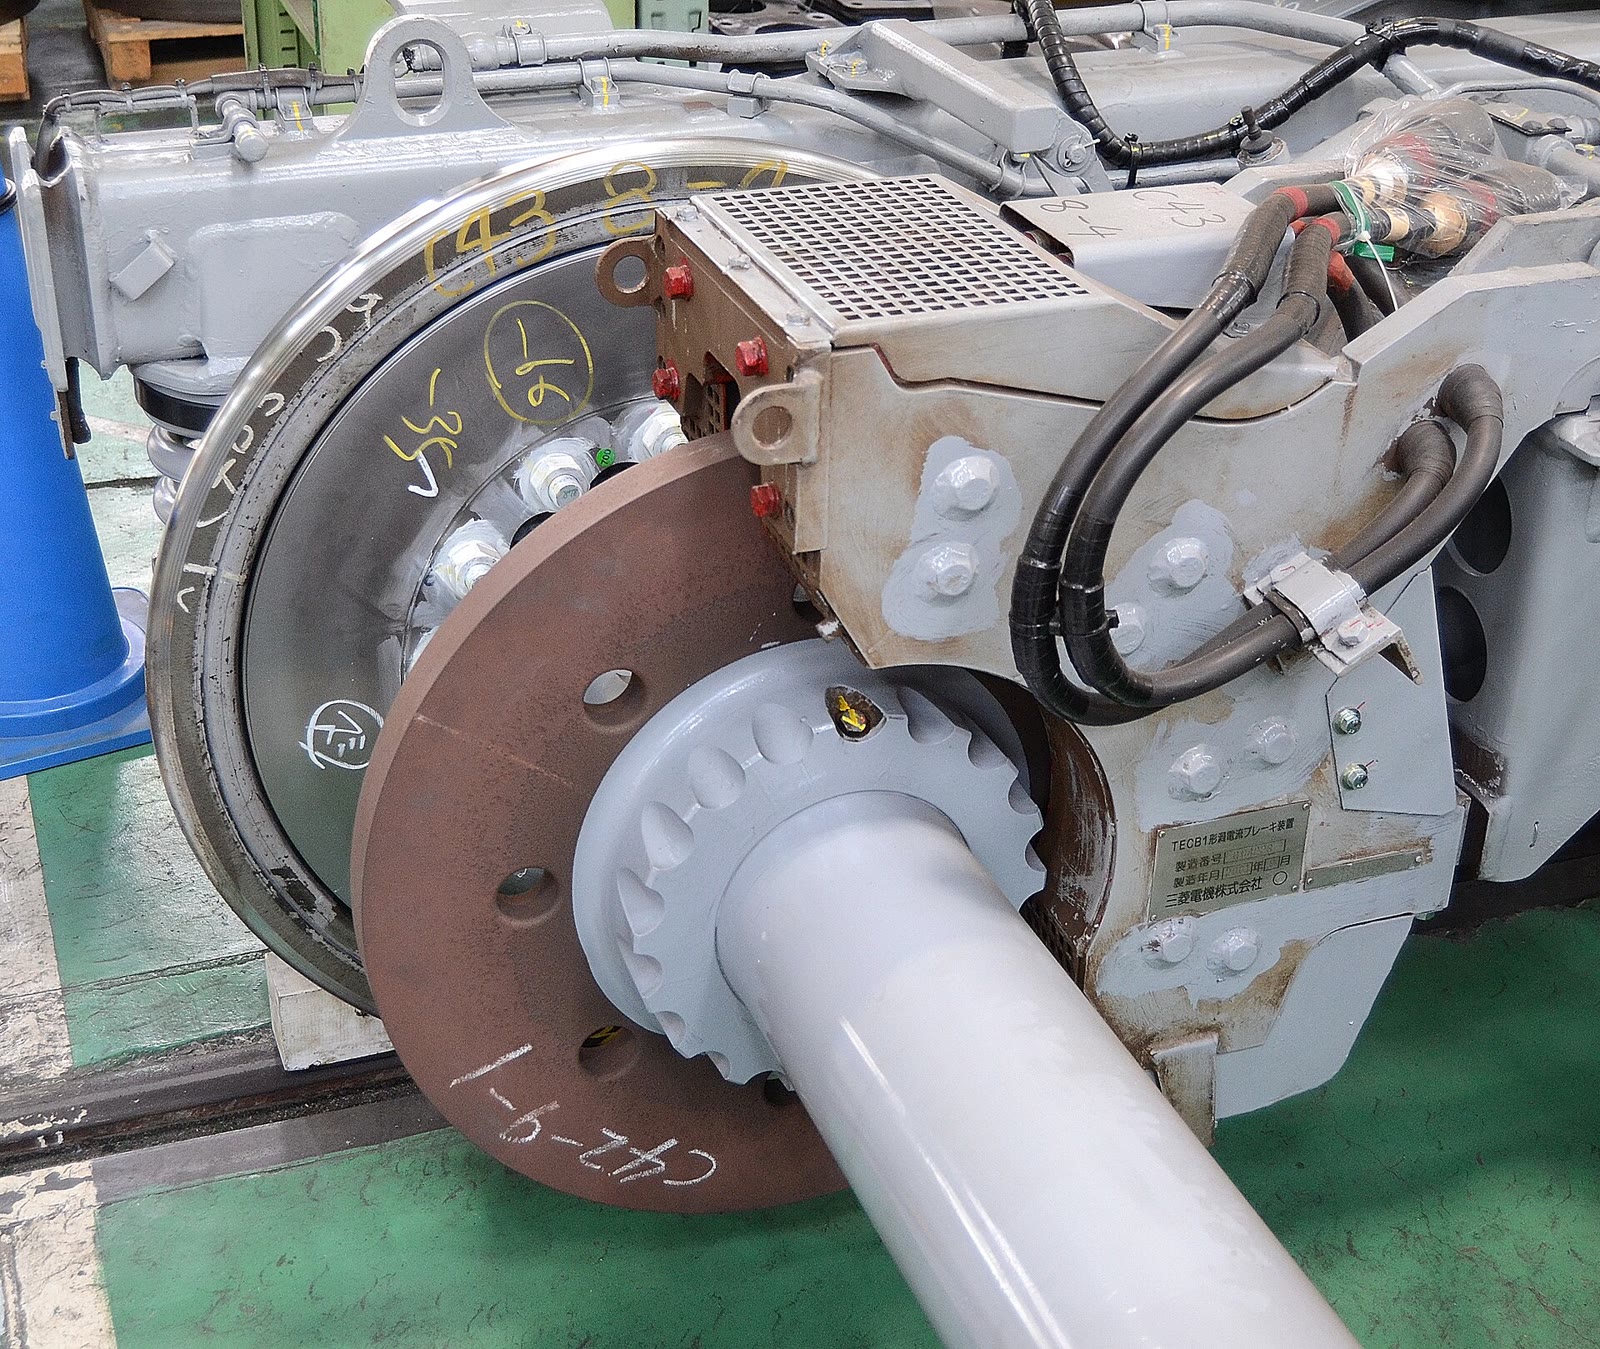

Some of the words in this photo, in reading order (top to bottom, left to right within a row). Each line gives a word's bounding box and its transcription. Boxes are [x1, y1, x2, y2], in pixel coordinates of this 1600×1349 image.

[1040, 199, 1123, 239] 8-4
[1132, 190, 1227, 228] C43
[1165, 875, 1263, 908] 三菱電機株式会社
